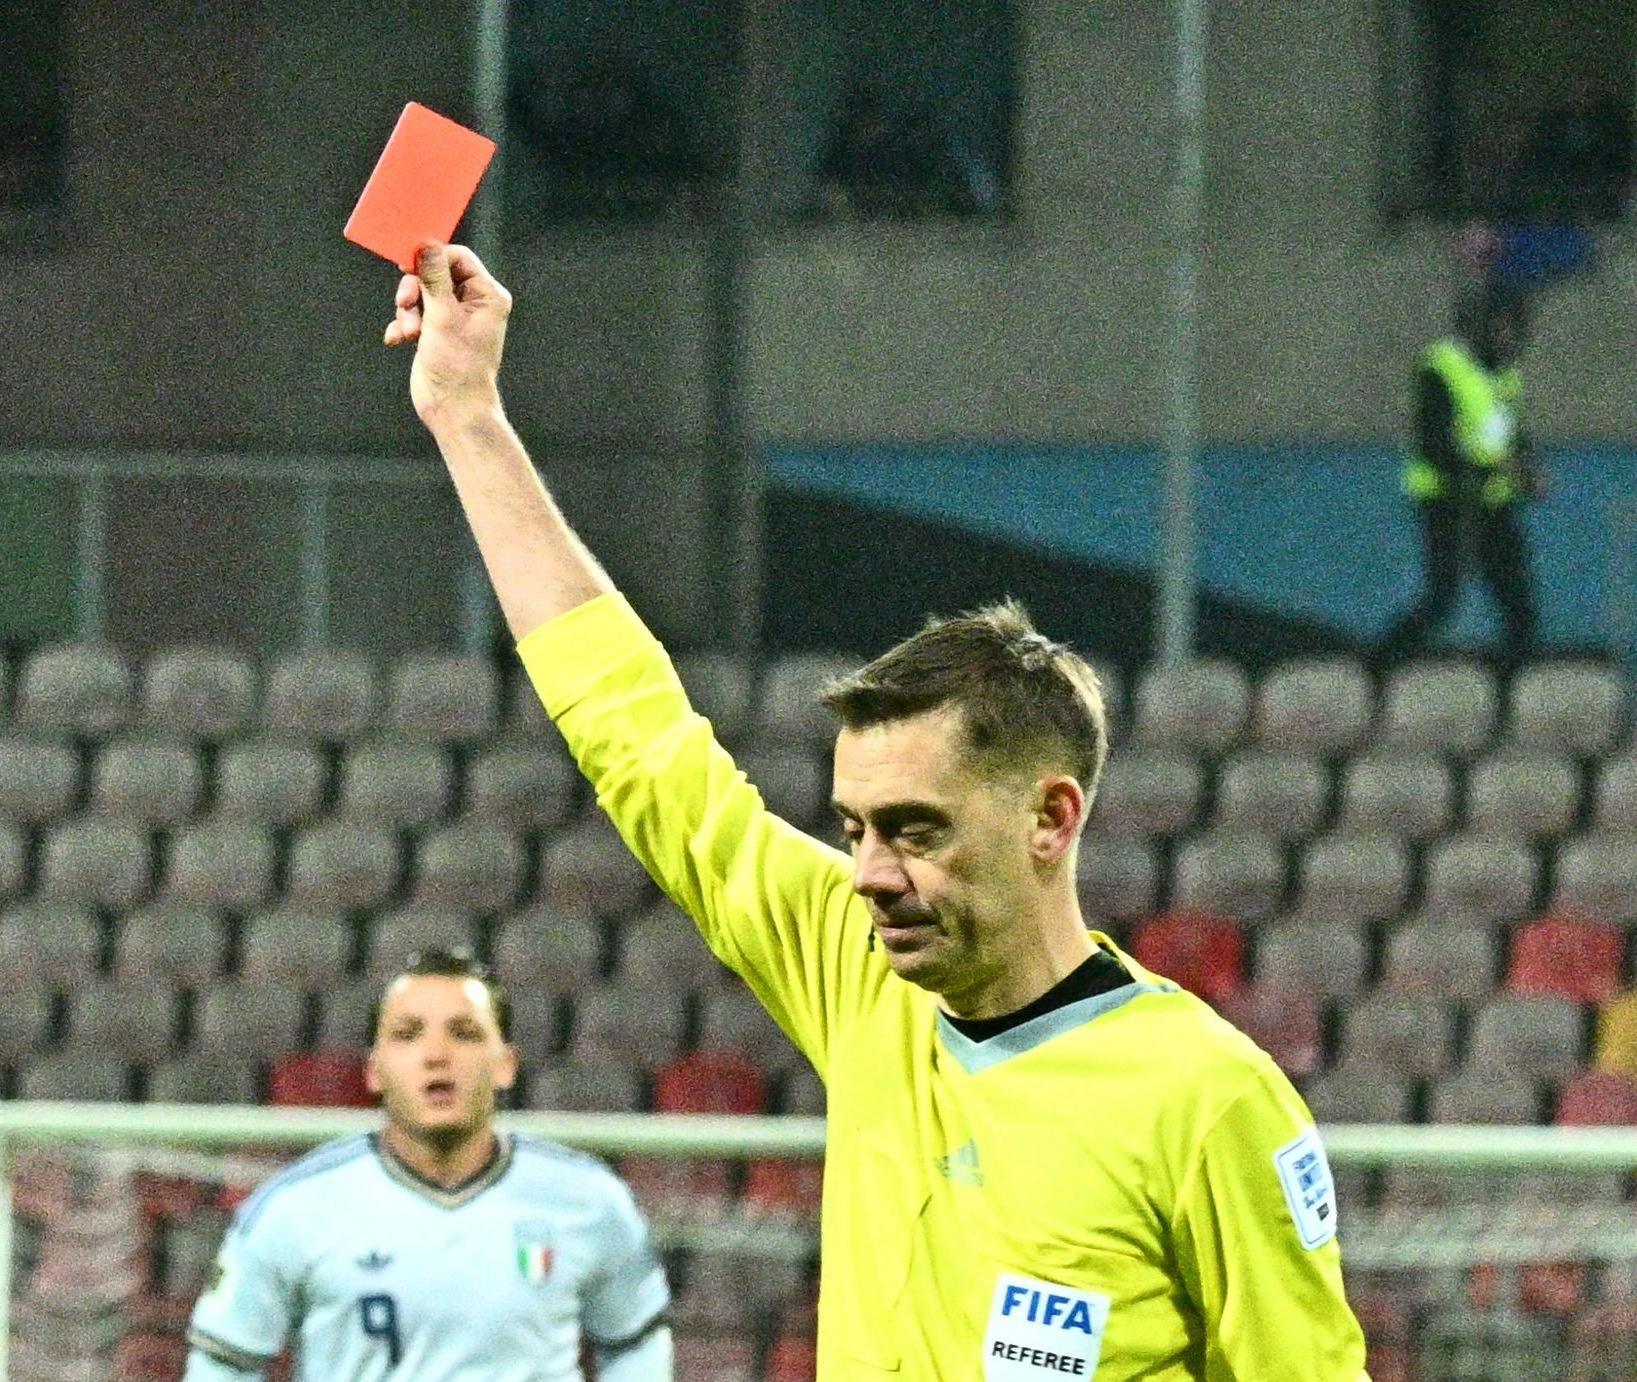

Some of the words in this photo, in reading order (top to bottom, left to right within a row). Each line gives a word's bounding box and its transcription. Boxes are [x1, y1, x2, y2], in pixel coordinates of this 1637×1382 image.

[359, 1293, 401, 1367] 9
[1002, 1285, 1093, 1335] FIFA
[992, 1340, 1086, 1376] REFEREE
